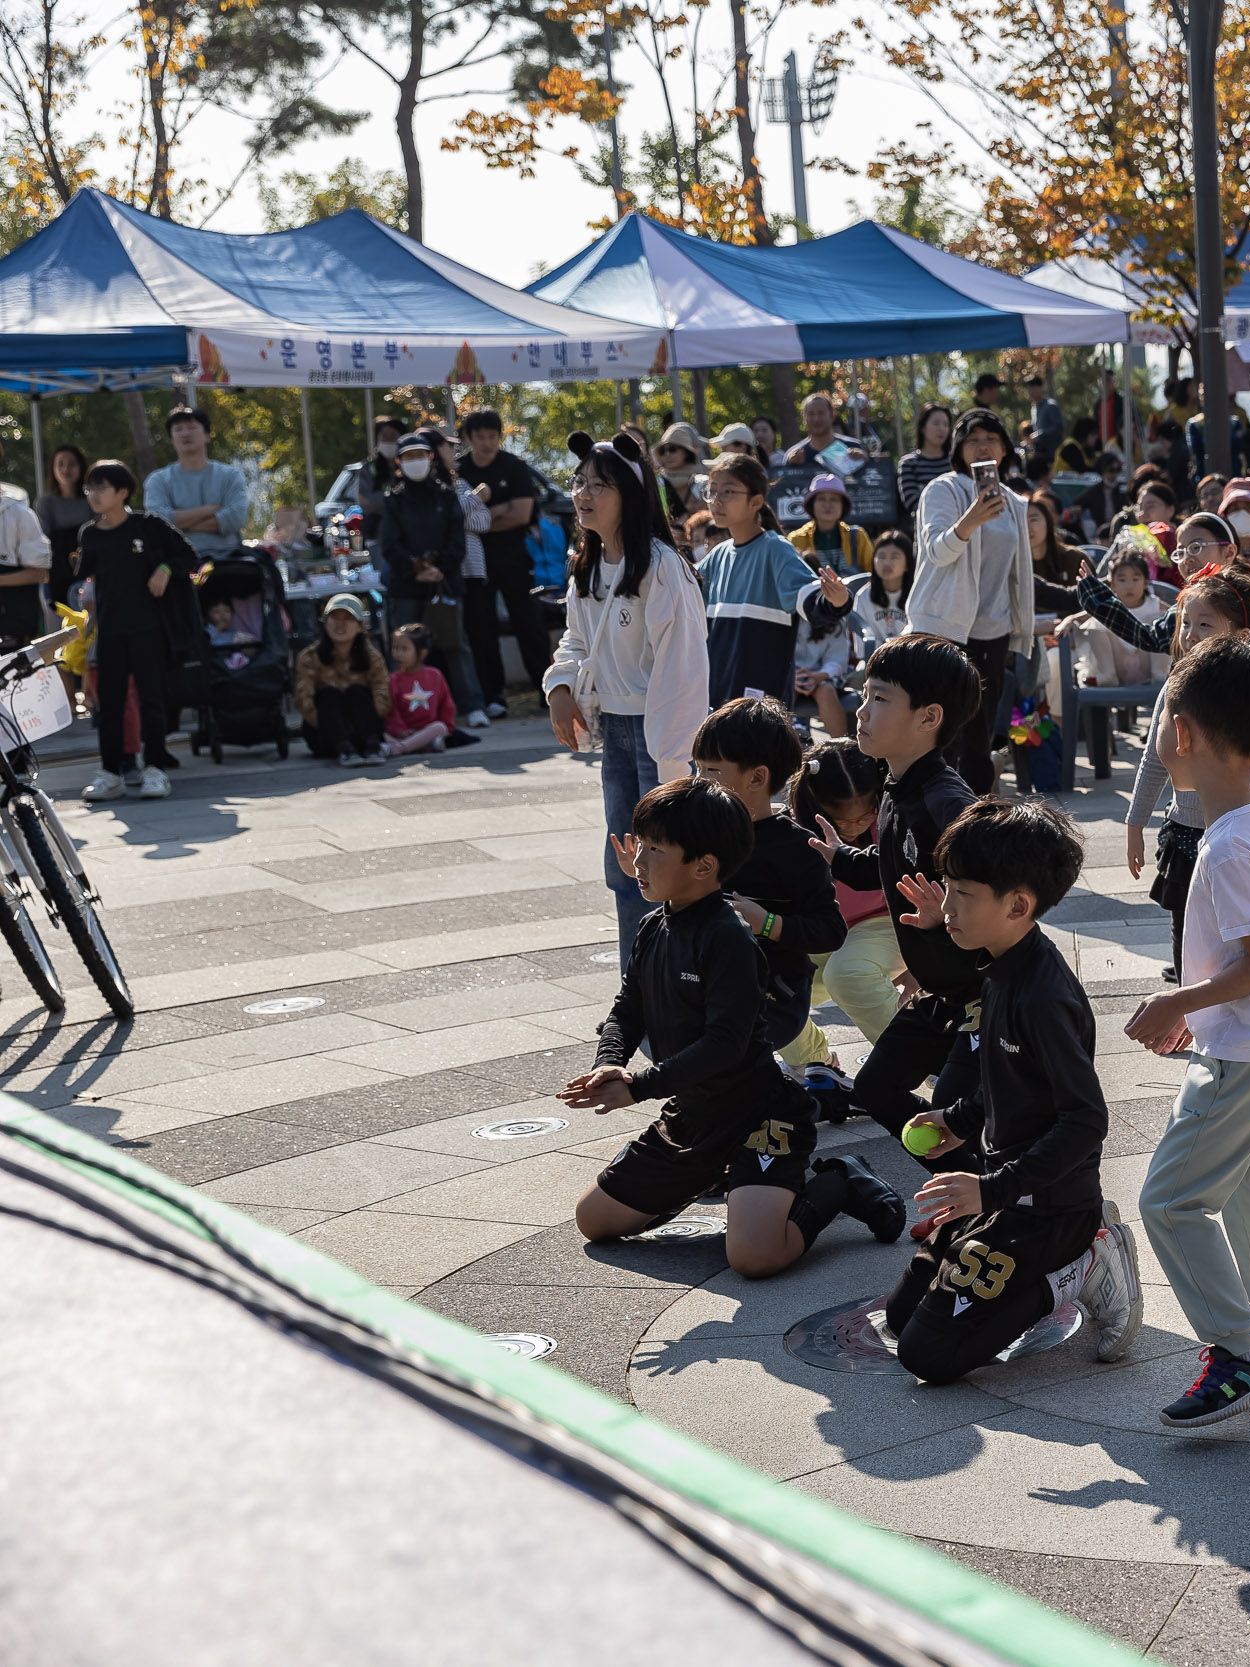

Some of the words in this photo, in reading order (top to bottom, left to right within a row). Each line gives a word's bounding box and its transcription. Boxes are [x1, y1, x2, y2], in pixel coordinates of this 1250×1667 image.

[281, 337, 399, 370] 운영본부
[527, 340, 619, 368] 안내부스
[743, 1118, 794, 1155] 45
[950, 1238, 1016, 1300] 53
